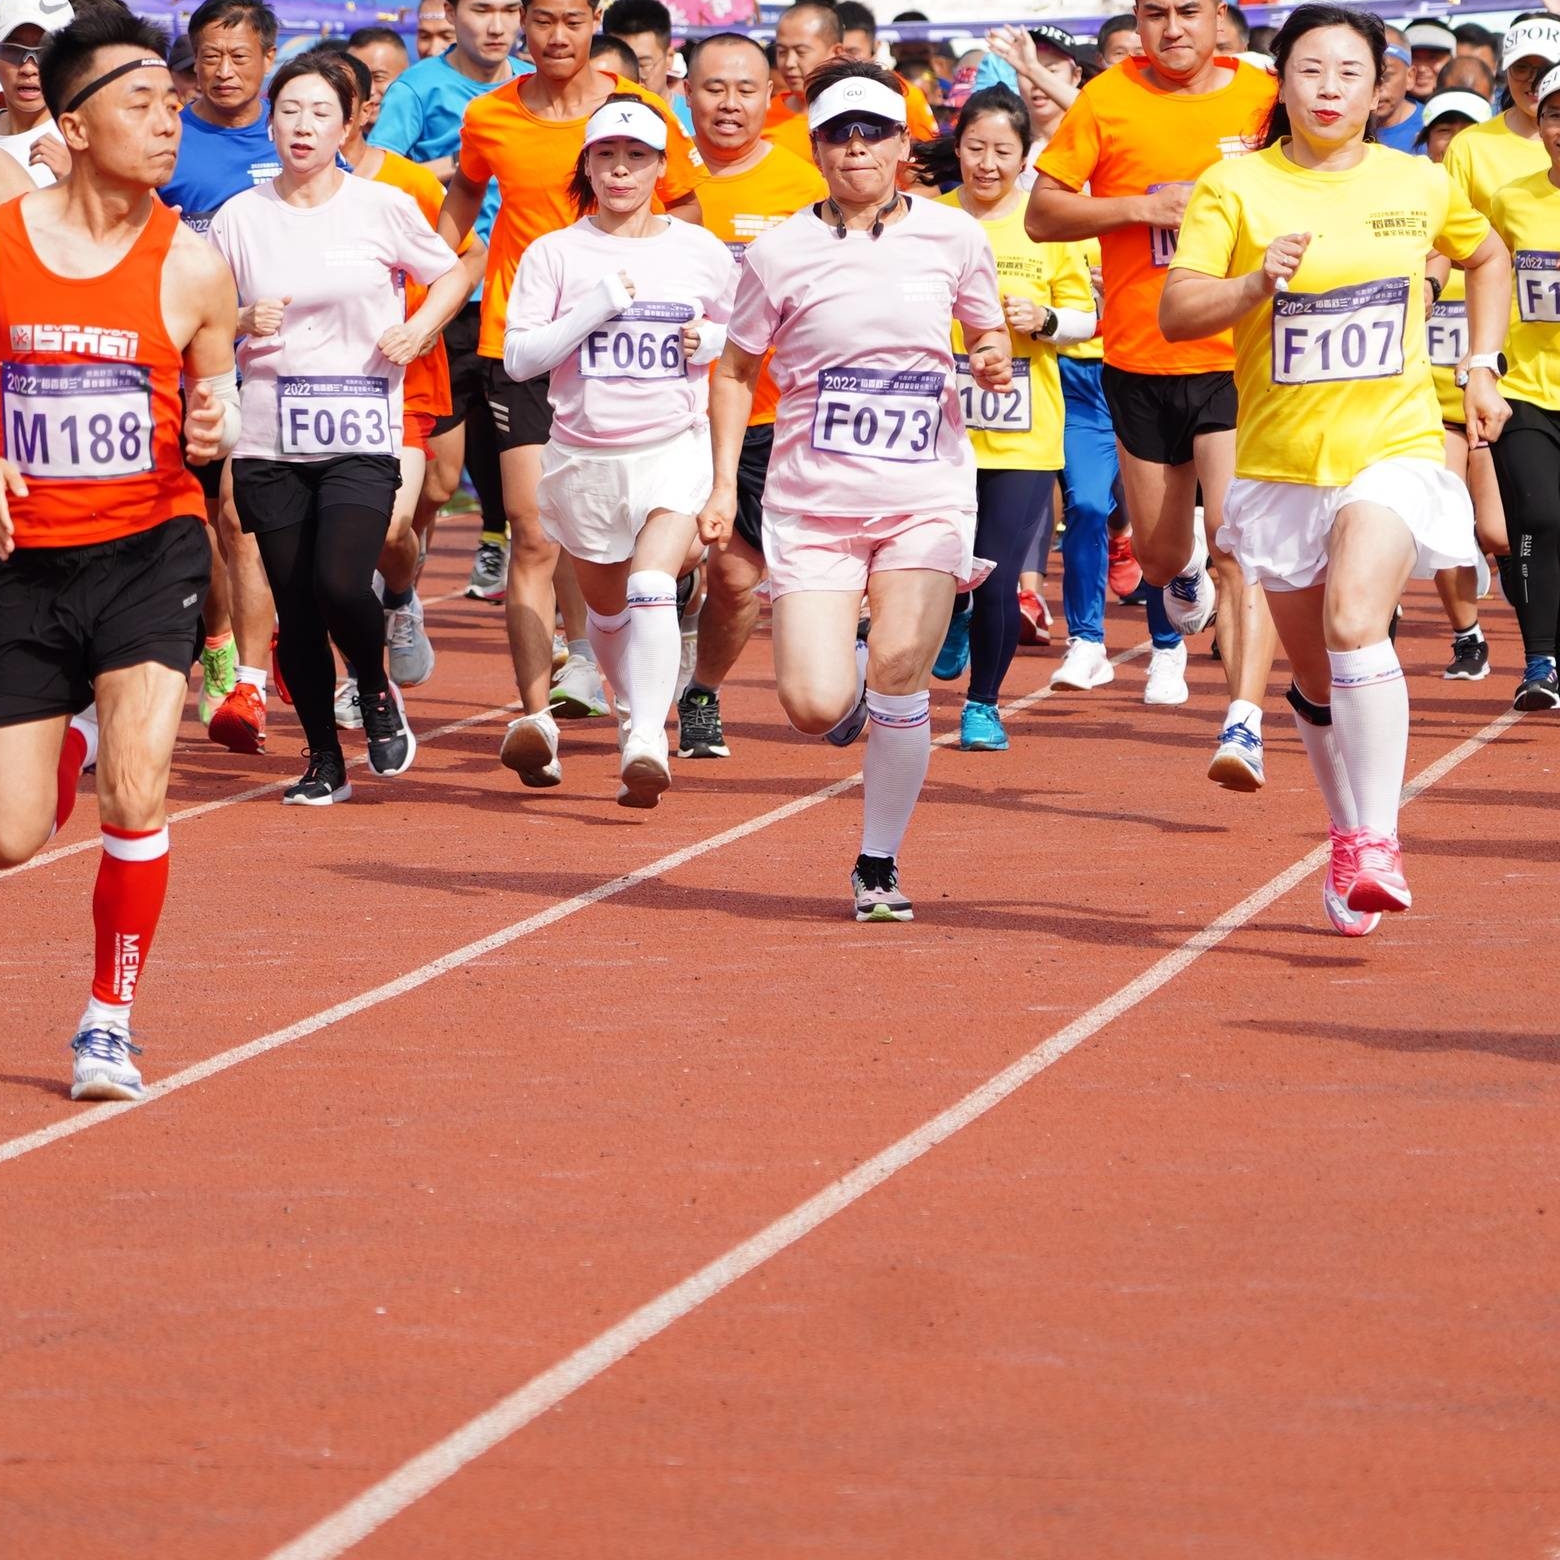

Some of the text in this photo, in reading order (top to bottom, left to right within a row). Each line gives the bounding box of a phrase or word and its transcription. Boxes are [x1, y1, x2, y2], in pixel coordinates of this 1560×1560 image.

[1520, 256, 1543, 270] 2022
[1279, 299, 1313, 315] 2022
[587, 330, 681, 370] F066
[1283, 320, 1395, 375] F107
[1428, 326, 1461, 358] F1
[7, 372, 38, 395] 2022
[284, 382, 311, 396] 2022
[824, 375, 858, 391] 2022
[959, 385, 1023, 422] 102
[12, 409, 141, 465] M188
[289, 407, 386, 447] F063
[823, 400, 932, 452] F073
[1523, 533, 1533, 557] RUN
